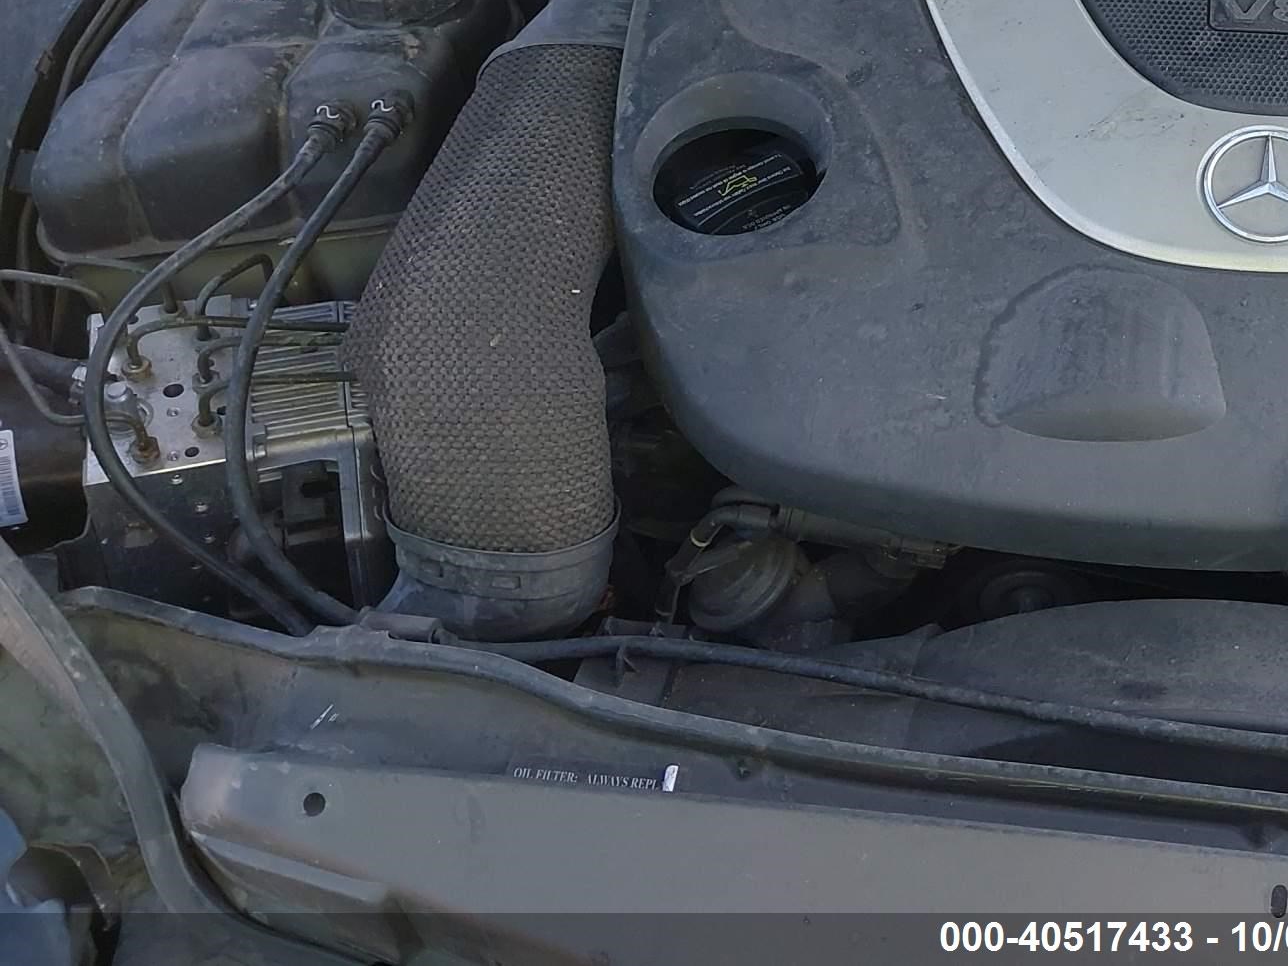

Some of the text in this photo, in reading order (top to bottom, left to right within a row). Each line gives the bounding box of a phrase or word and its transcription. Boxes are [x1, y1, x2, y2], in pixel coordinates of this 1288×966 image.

[513, 767, 533, 779] OIL
[536, 769, 578, 783] FILTER:
[585, 774, 629, 787] ALWAYS
